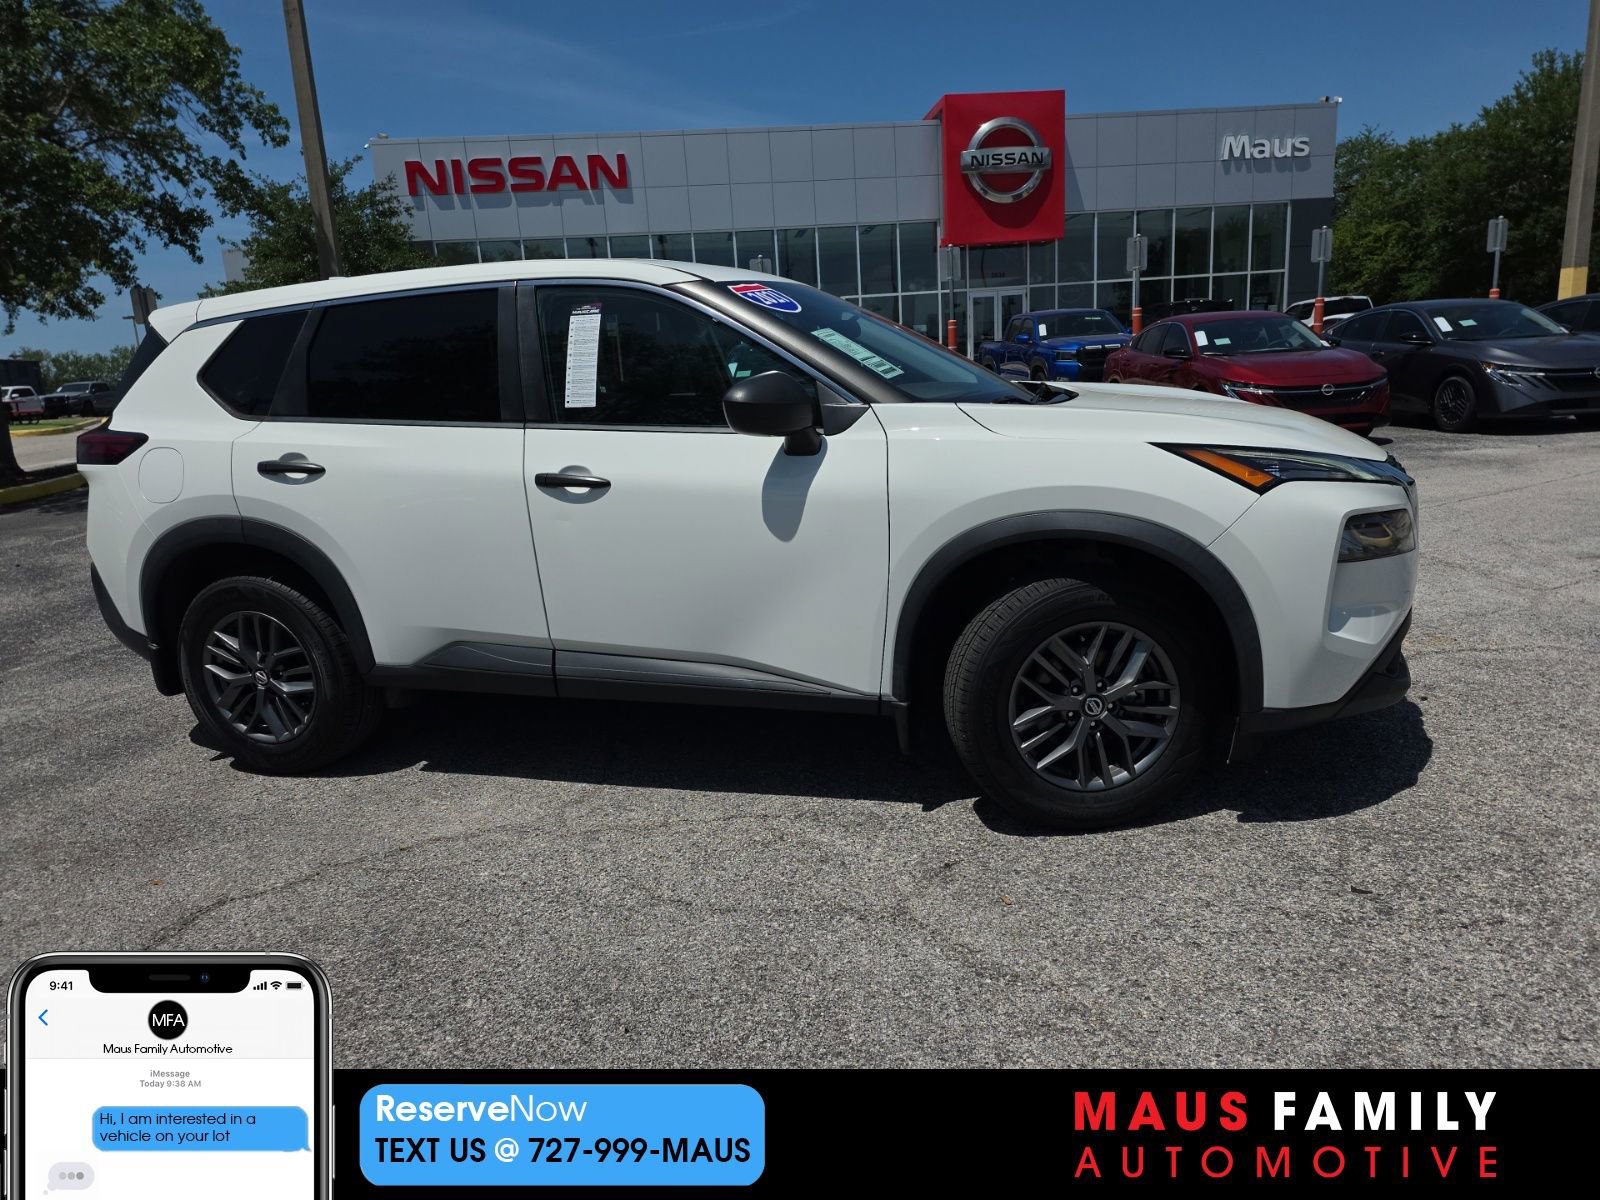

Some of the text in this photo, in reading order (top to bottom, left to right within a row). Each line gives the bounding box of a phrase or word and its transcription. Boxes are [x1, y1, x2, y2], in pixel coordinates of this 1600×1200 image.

[970, 152, 1044, 167] NISSAN
[1221, 135, 1310, 160] Maus
[405, 154, 628, 196] NISSAN
